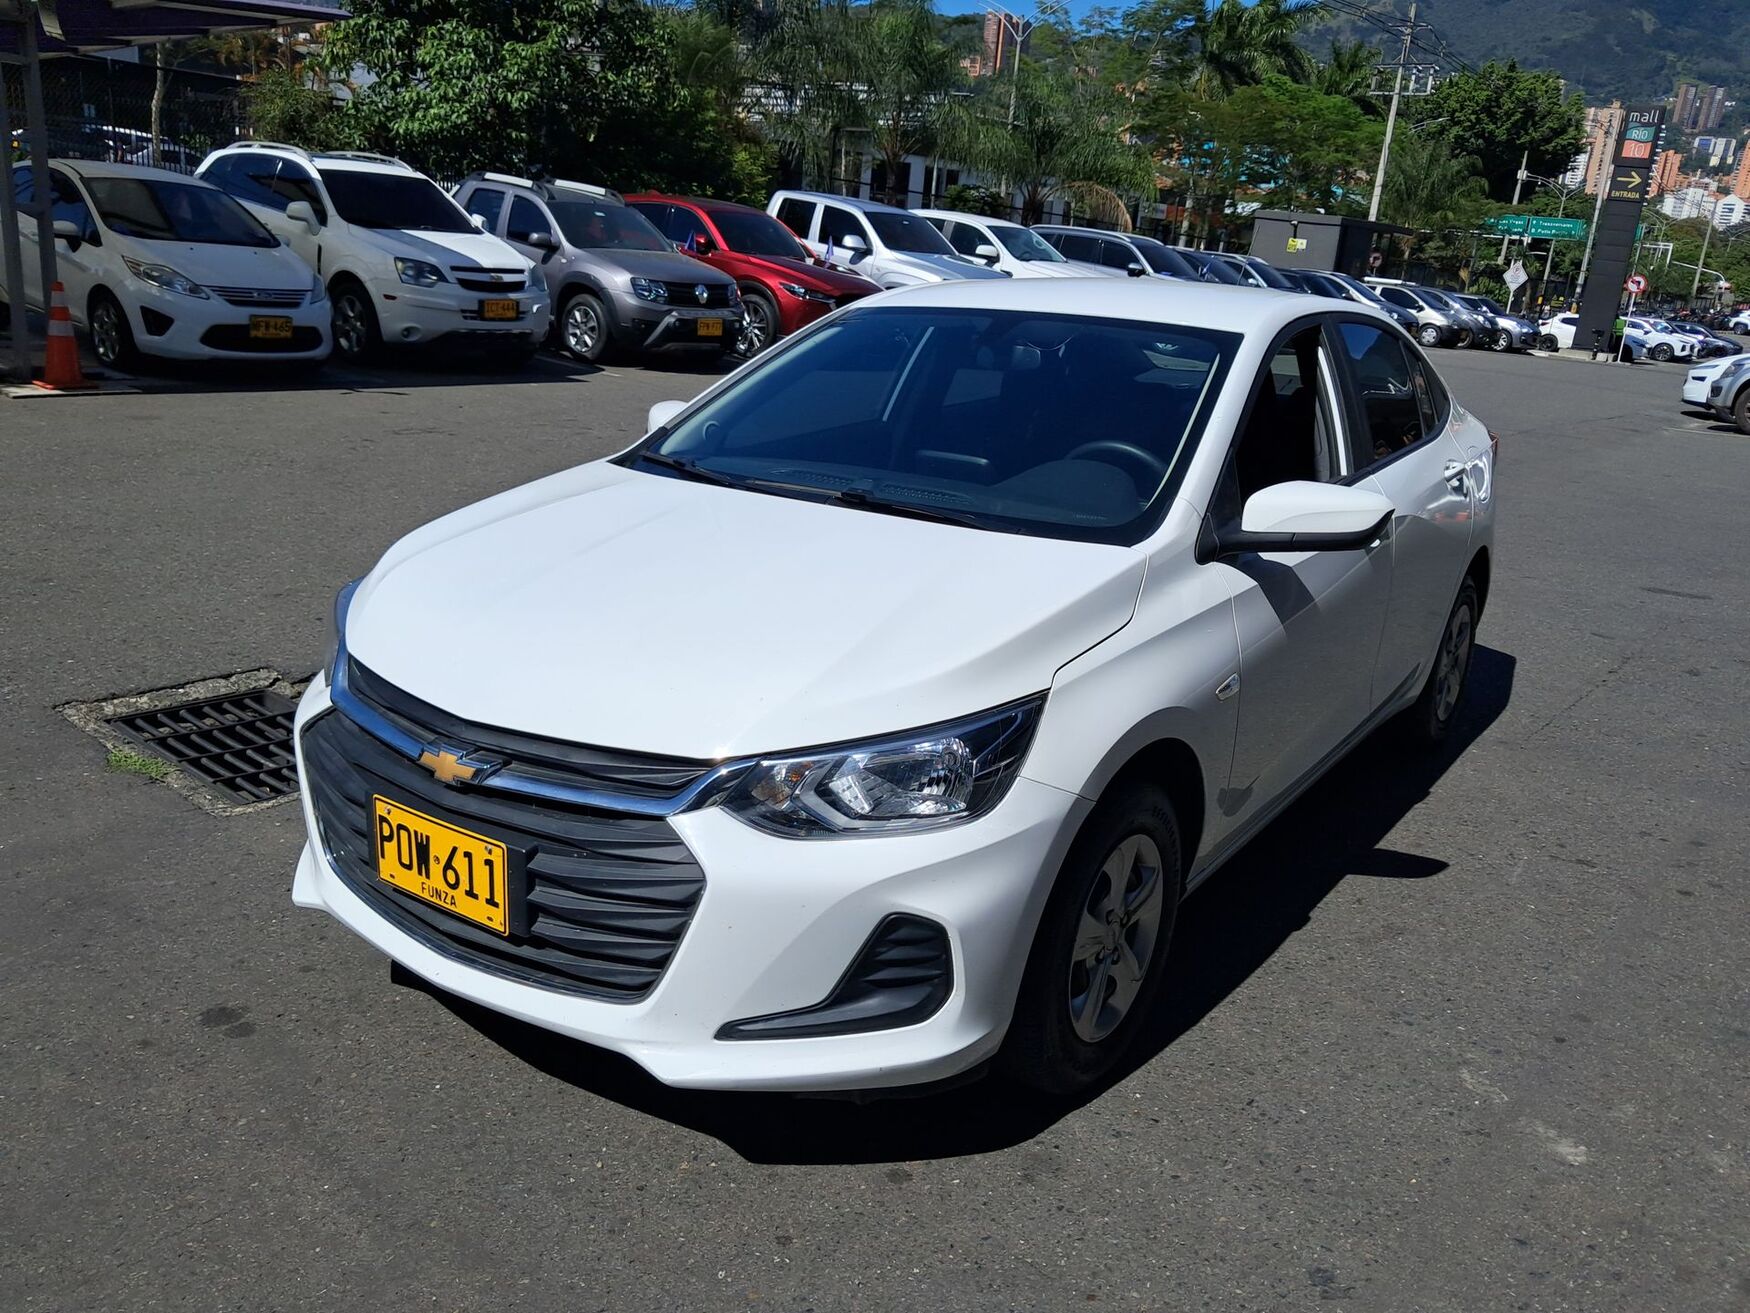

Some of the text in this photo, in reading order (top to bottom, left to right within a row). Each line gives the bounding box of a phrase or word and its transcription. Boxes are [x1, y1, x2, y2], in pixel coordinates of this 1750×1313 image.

[1629, 109, 1660, 123] mall
[1629, 143, 1645, 158] 10
[1611, 190, 1640, 199] ENTRADA
[378, 813, 500, 909] POW 611
[421, 881, 457, 909] FUNZA
